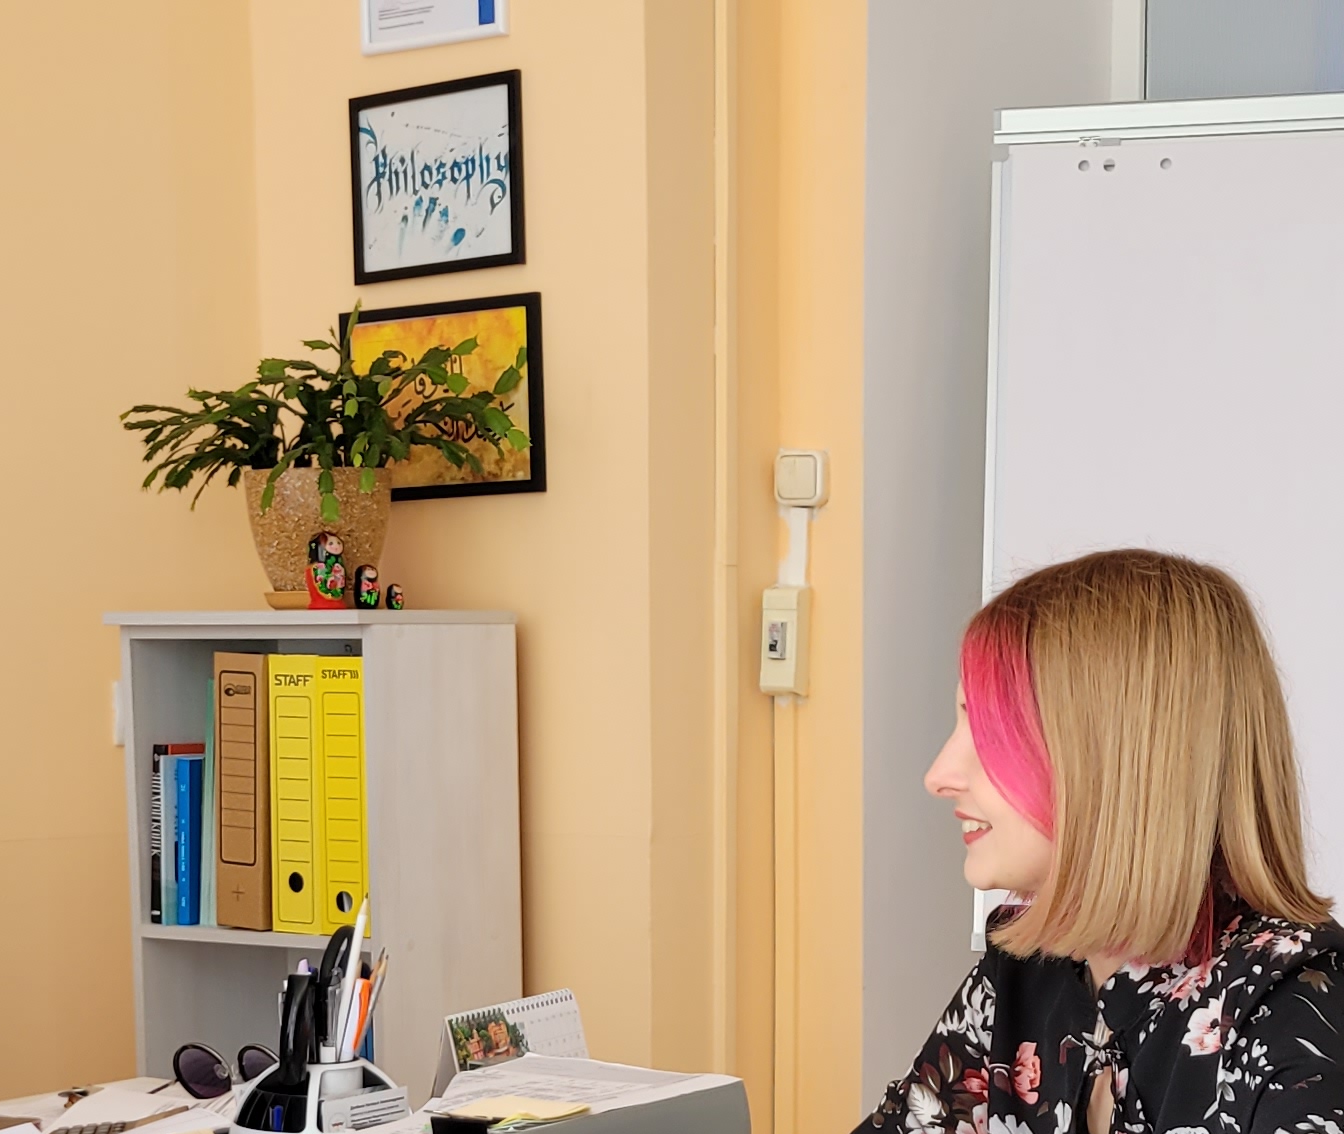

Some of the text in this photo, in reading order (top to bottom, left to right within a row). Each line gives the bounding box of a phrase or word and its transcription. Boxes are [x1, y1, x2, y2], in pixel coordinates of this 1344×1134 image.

[367, 143, 509, 215] Philosophy
[274, 673, 311, 686] STAFF
[321, 670, 349, 679] STAFF
